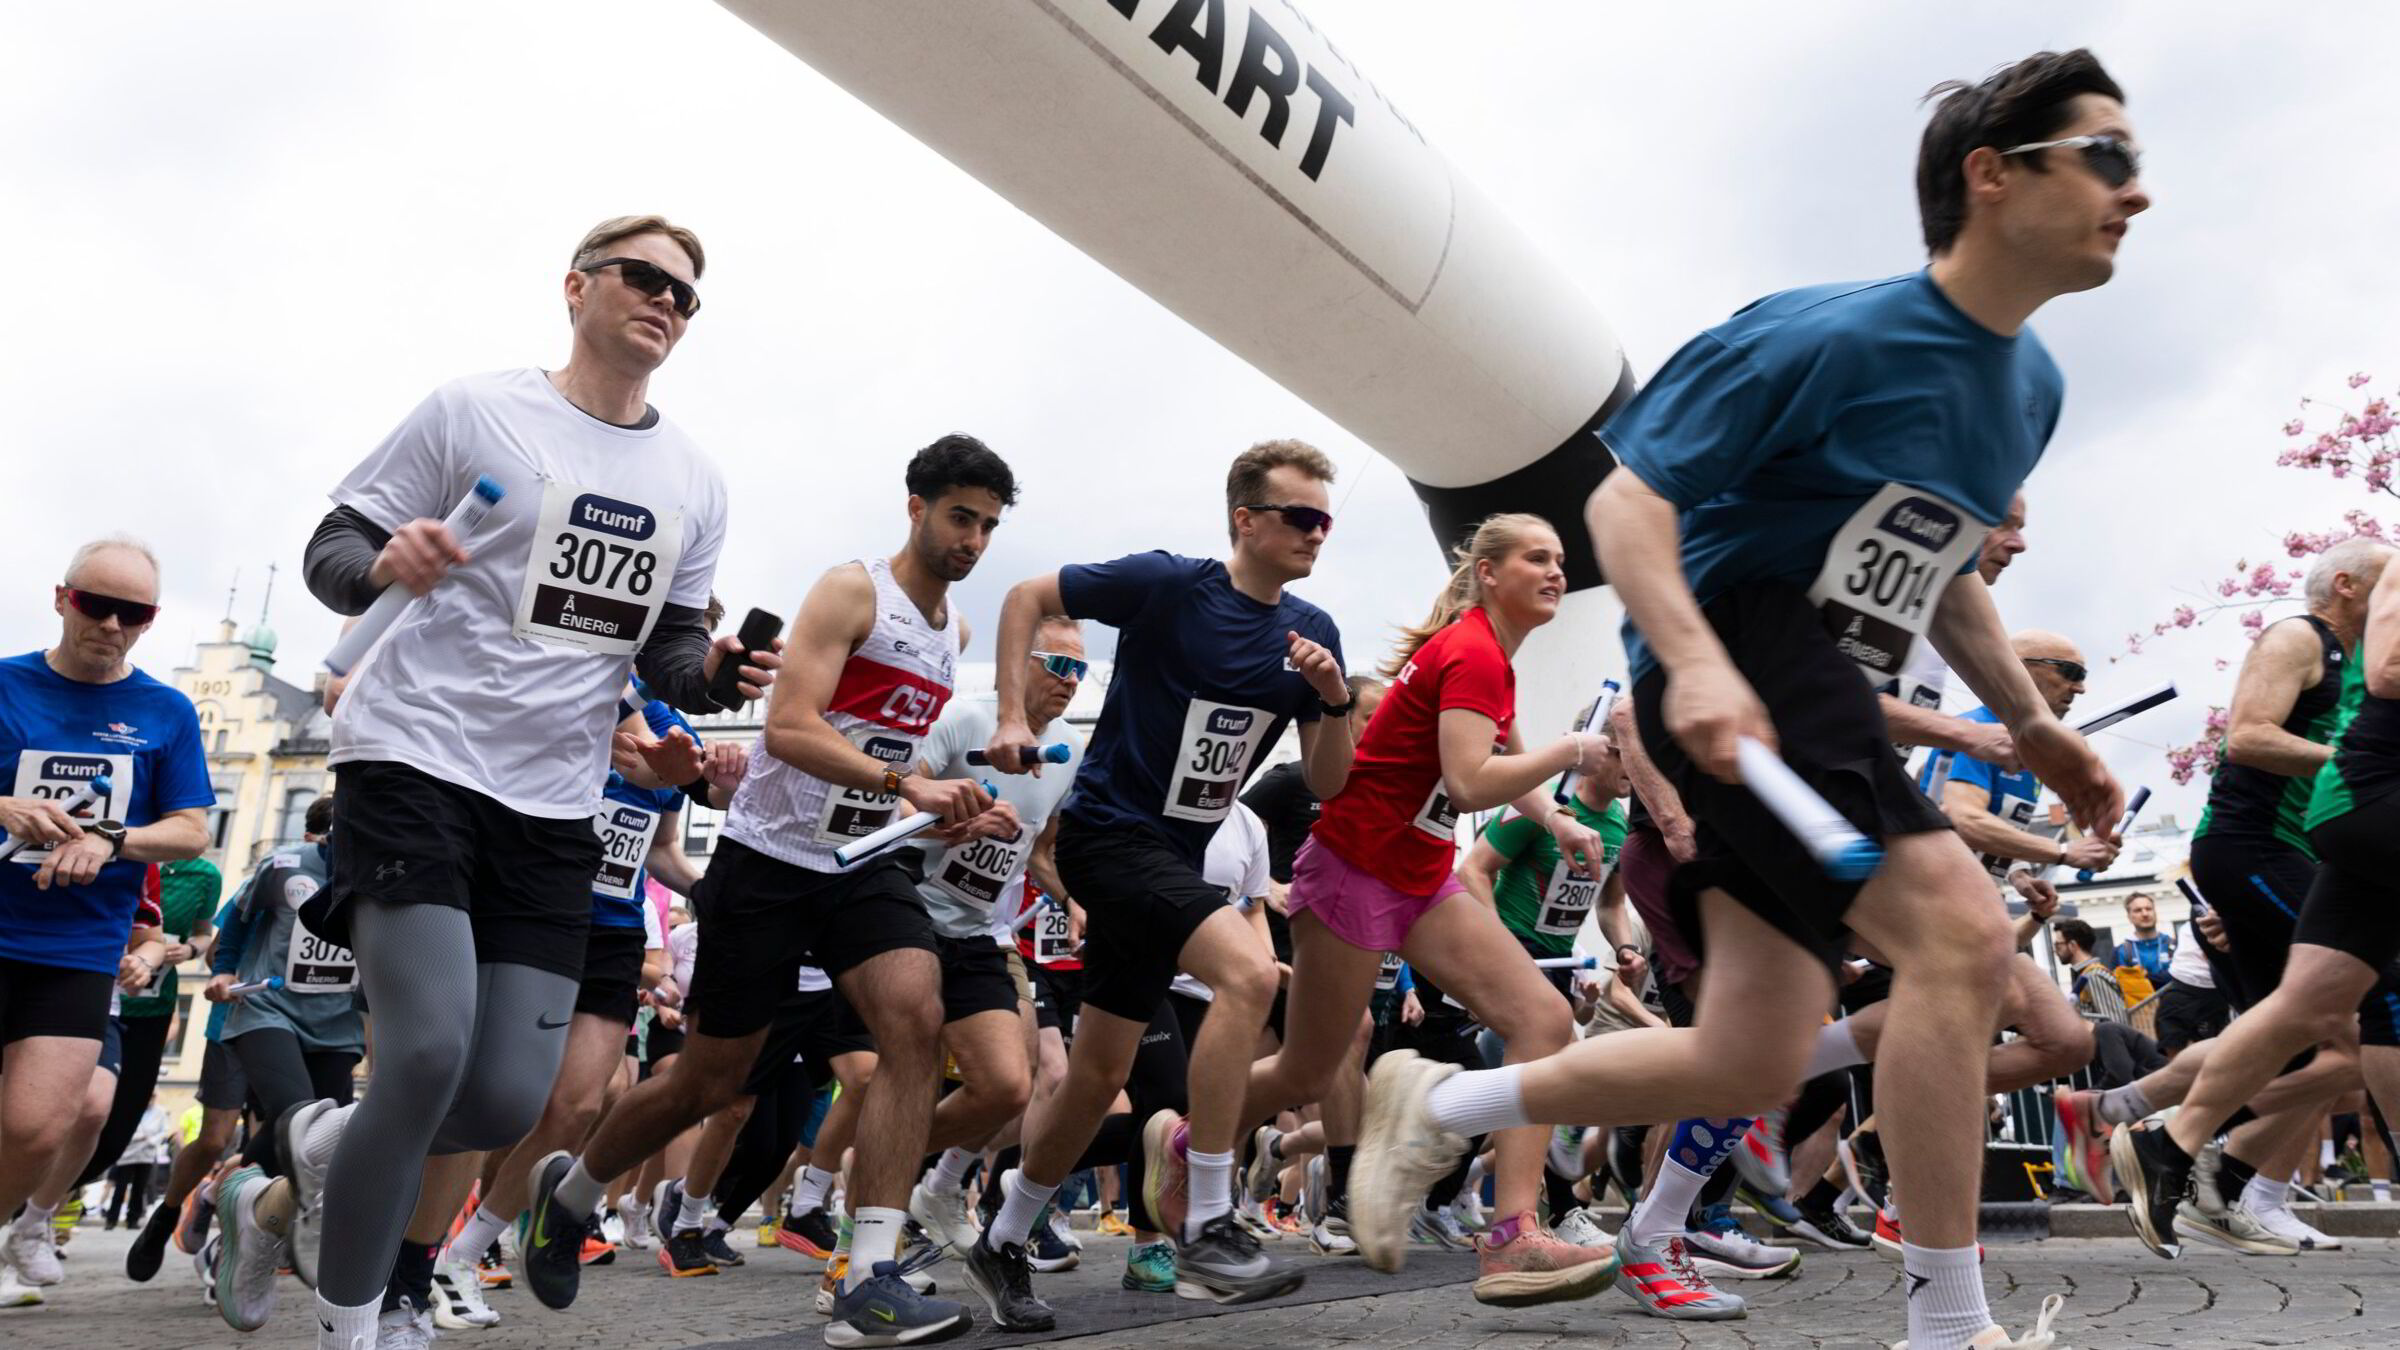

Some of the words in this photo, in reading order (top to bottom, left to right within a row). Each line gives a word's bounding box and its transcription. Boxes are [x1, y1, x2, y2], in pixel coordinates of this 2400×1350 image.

[1107, 0, 1354, 182] ART
[583, 503, 646, 533] trumf
[1893, 505, 1955, 544] trumf
[549, 532, 657, 596] 3078
[1846, 538, 1940, 620] 3014
[562, 594, 575, 612] Å
[559, 612, 620, 635] ENERGI
[871, 743, 910, 761] trumf
[1191, 737, 1248, 775] 3042
[52, 762, 106, 777] trumf
[619, 812, 649, 828] trumf
[601, 829, 645, 863] 2613
[960, 839, 1018, 877] 3005
[957, 880, 993, 900] ENERGI
[1554, 883, 1597, 907] 2801
